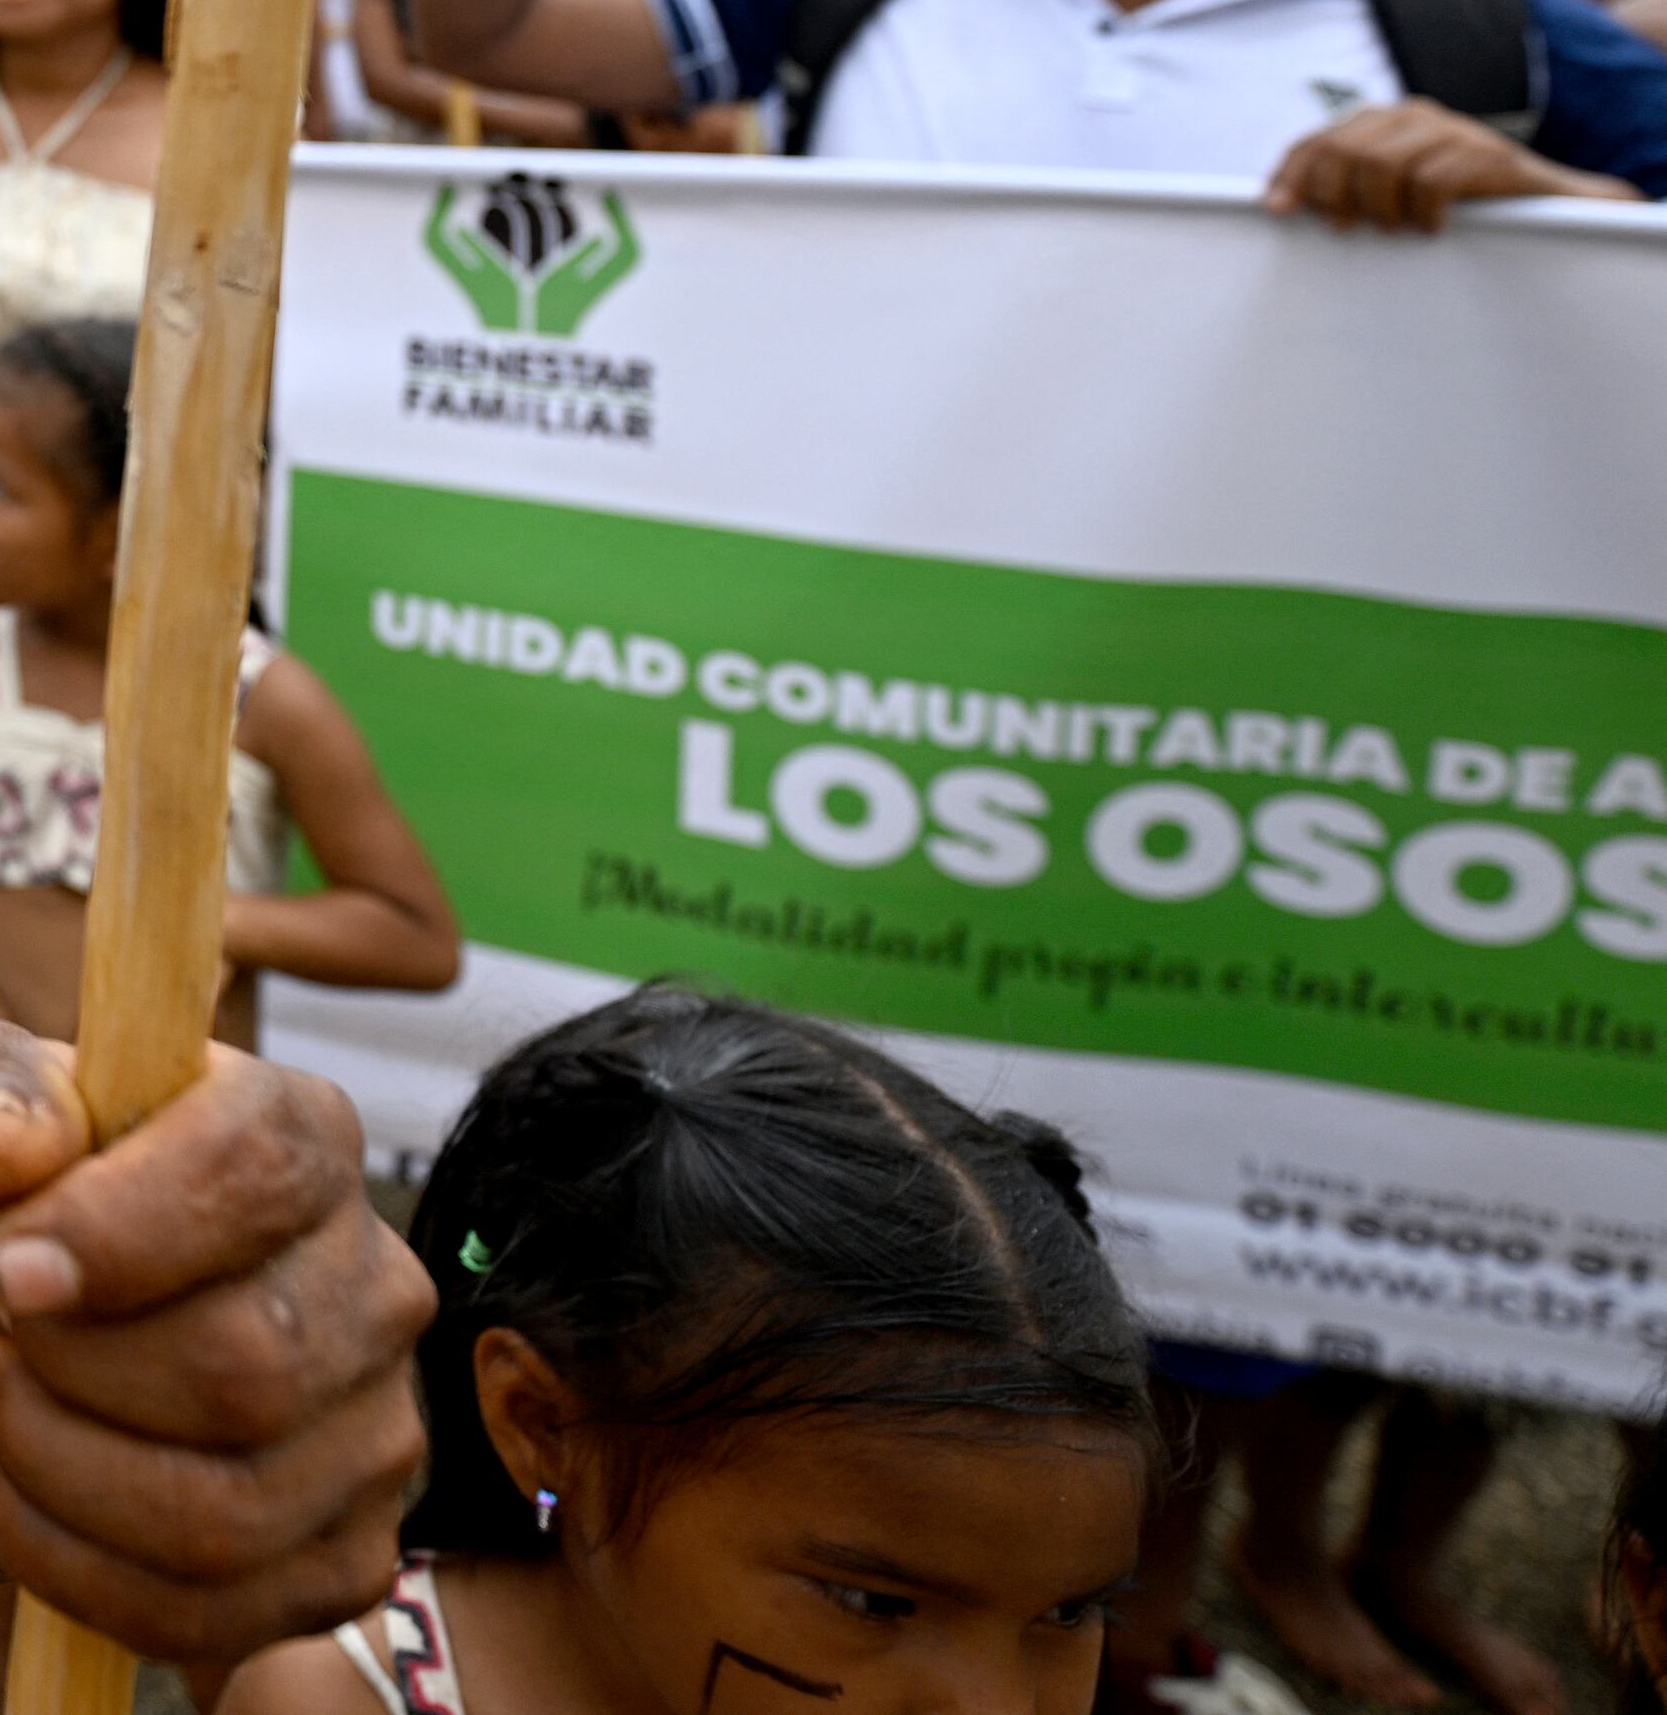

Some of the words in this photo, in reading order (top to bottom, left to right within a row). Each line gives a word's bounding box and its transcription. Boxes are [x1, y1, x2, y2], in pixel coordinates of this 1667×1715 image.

[402, 384, 654, 445] FAMILIAR
[404, 332, 655, 392] BIENESTAR
[370, 588, 689, 698] UNIDAD
[697, 648, 1411, 794] COMUNITARIA
[1427, 736, 1575, 814] DE
[677, 716, 1051, 888] LOS
[1085, 778, 1667, 964] OSOS
